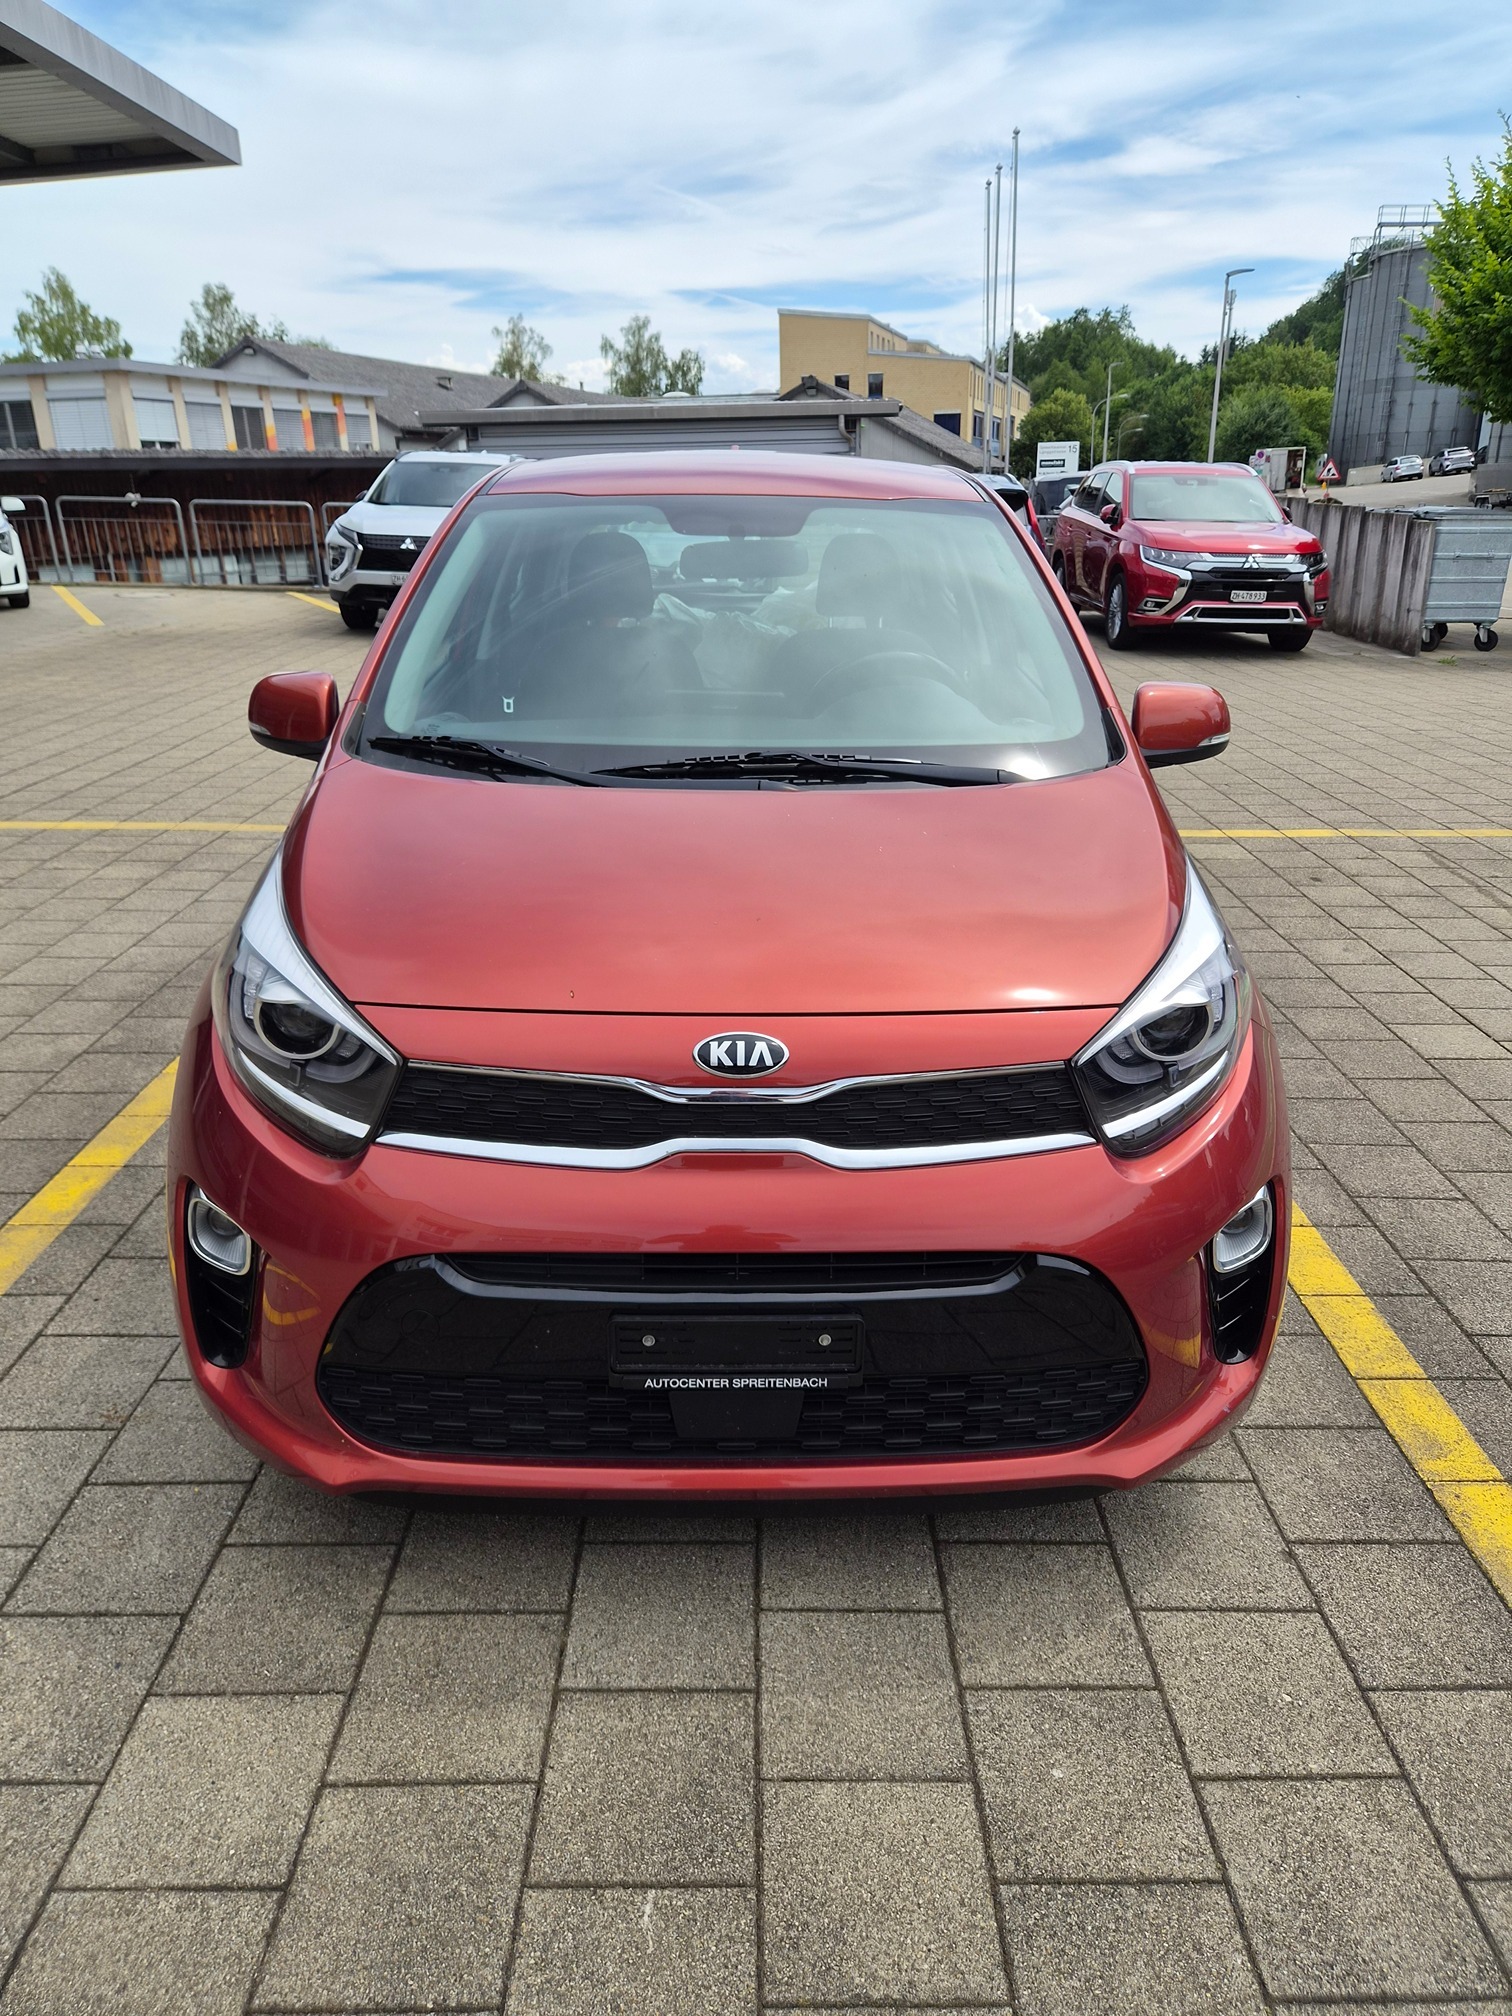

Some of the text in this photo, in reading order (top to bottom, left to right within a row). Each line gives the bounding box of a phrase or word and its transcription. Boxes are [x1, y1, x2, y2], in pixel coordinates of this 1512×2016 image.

[1068, 444, 1078, 454] 15
[709, 1040, 774, 1067] KIA
[644, 1377, 828, 1389] AUTOCENTER SPREITENBACH
